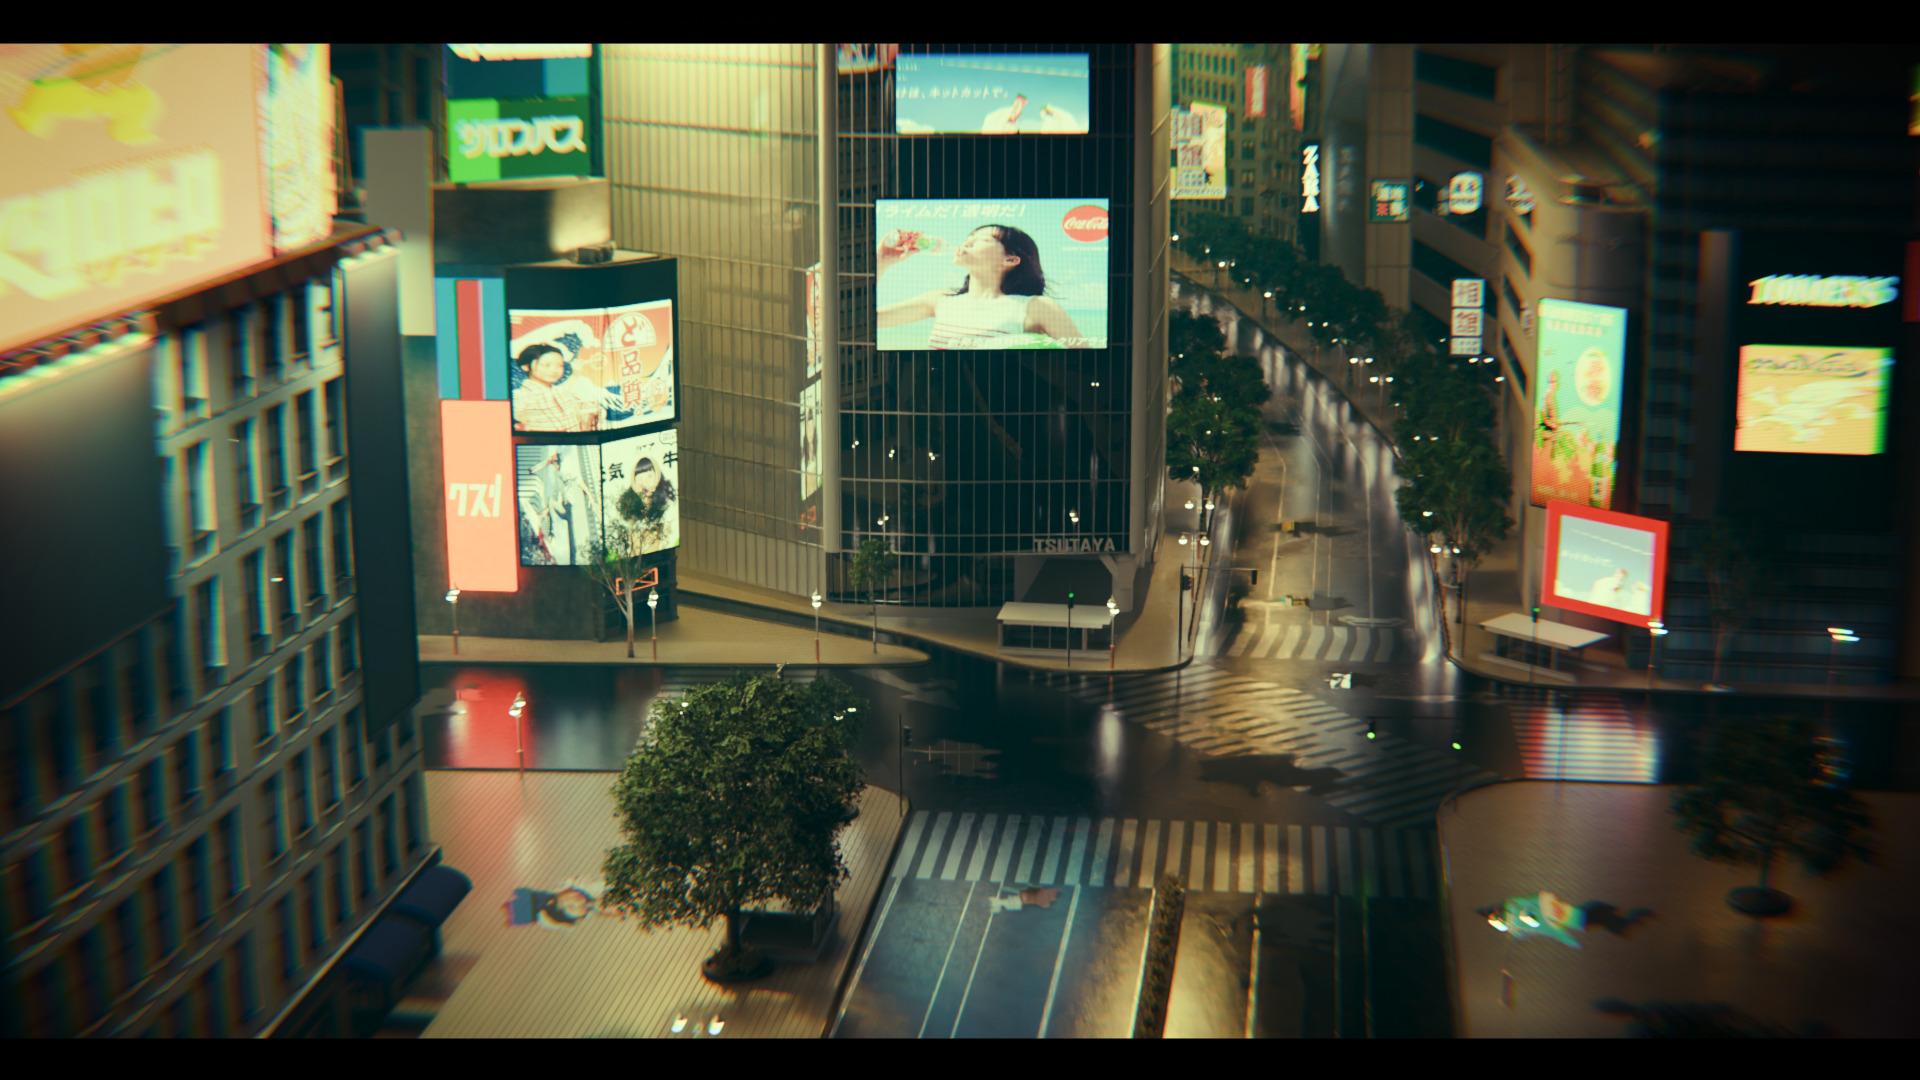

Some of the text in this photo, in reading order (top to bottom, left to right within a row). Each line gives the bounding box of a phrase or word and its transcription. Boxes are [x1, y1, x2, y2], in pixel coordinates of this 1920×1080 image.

[1301, 145, 1320, 213] ZARA
[620, 316, 644, 416] ど品質。
[449, 473, 502, 517] クスリ
[1033, 538, 1115, 553] TSUTAYA
